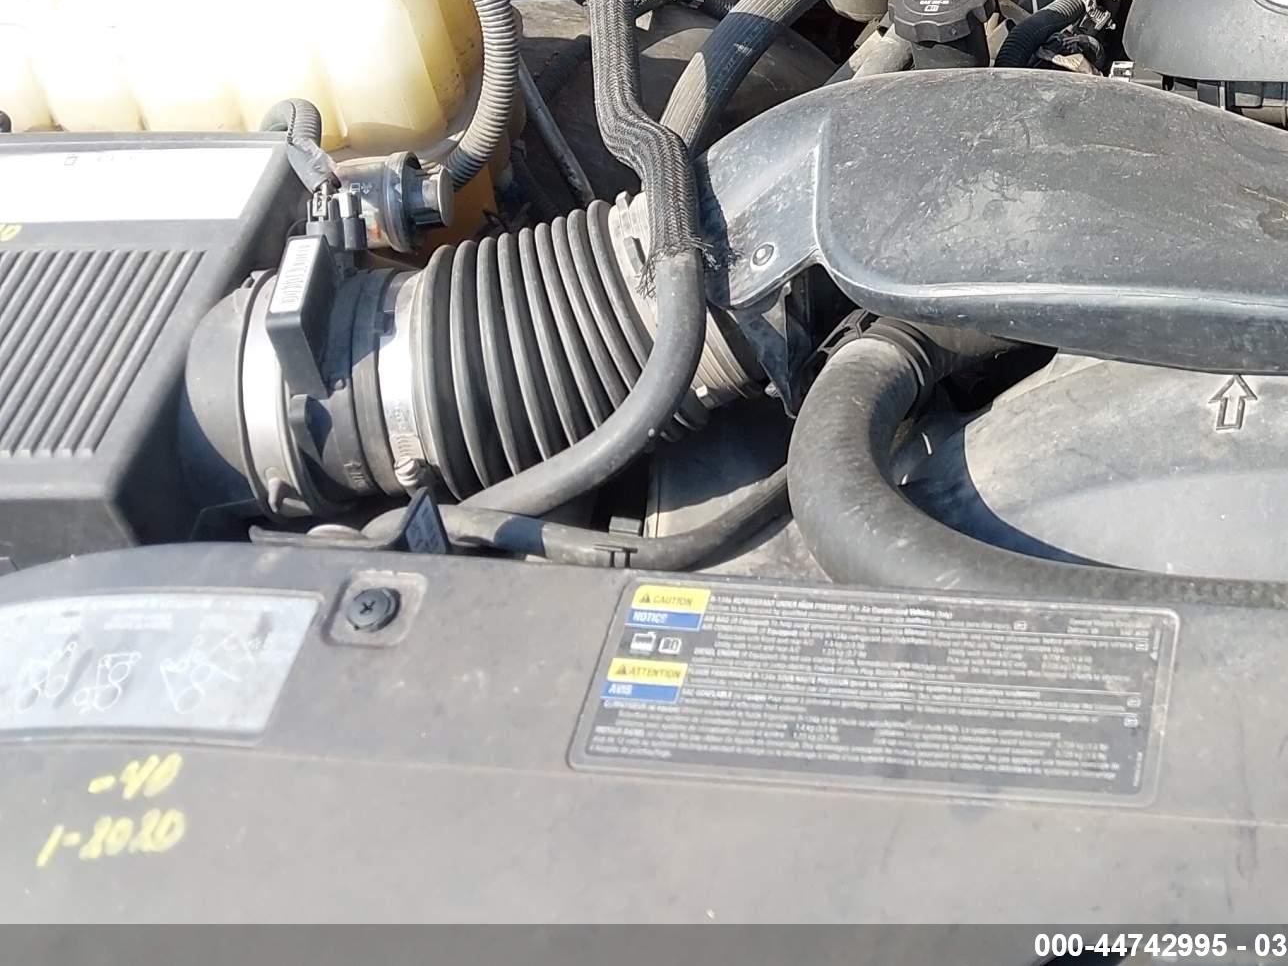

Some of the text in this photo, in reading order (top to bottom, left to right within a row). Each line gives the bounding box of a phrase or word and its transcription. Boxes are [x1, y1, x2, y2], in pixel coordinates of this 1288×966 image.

[653, 594, 694, 606] CAUTION
[632, 611, 668, 624] NOTICE
[628, 668, 682, 680] ATTENTION
[608, 684, 633, 696] AVIS
